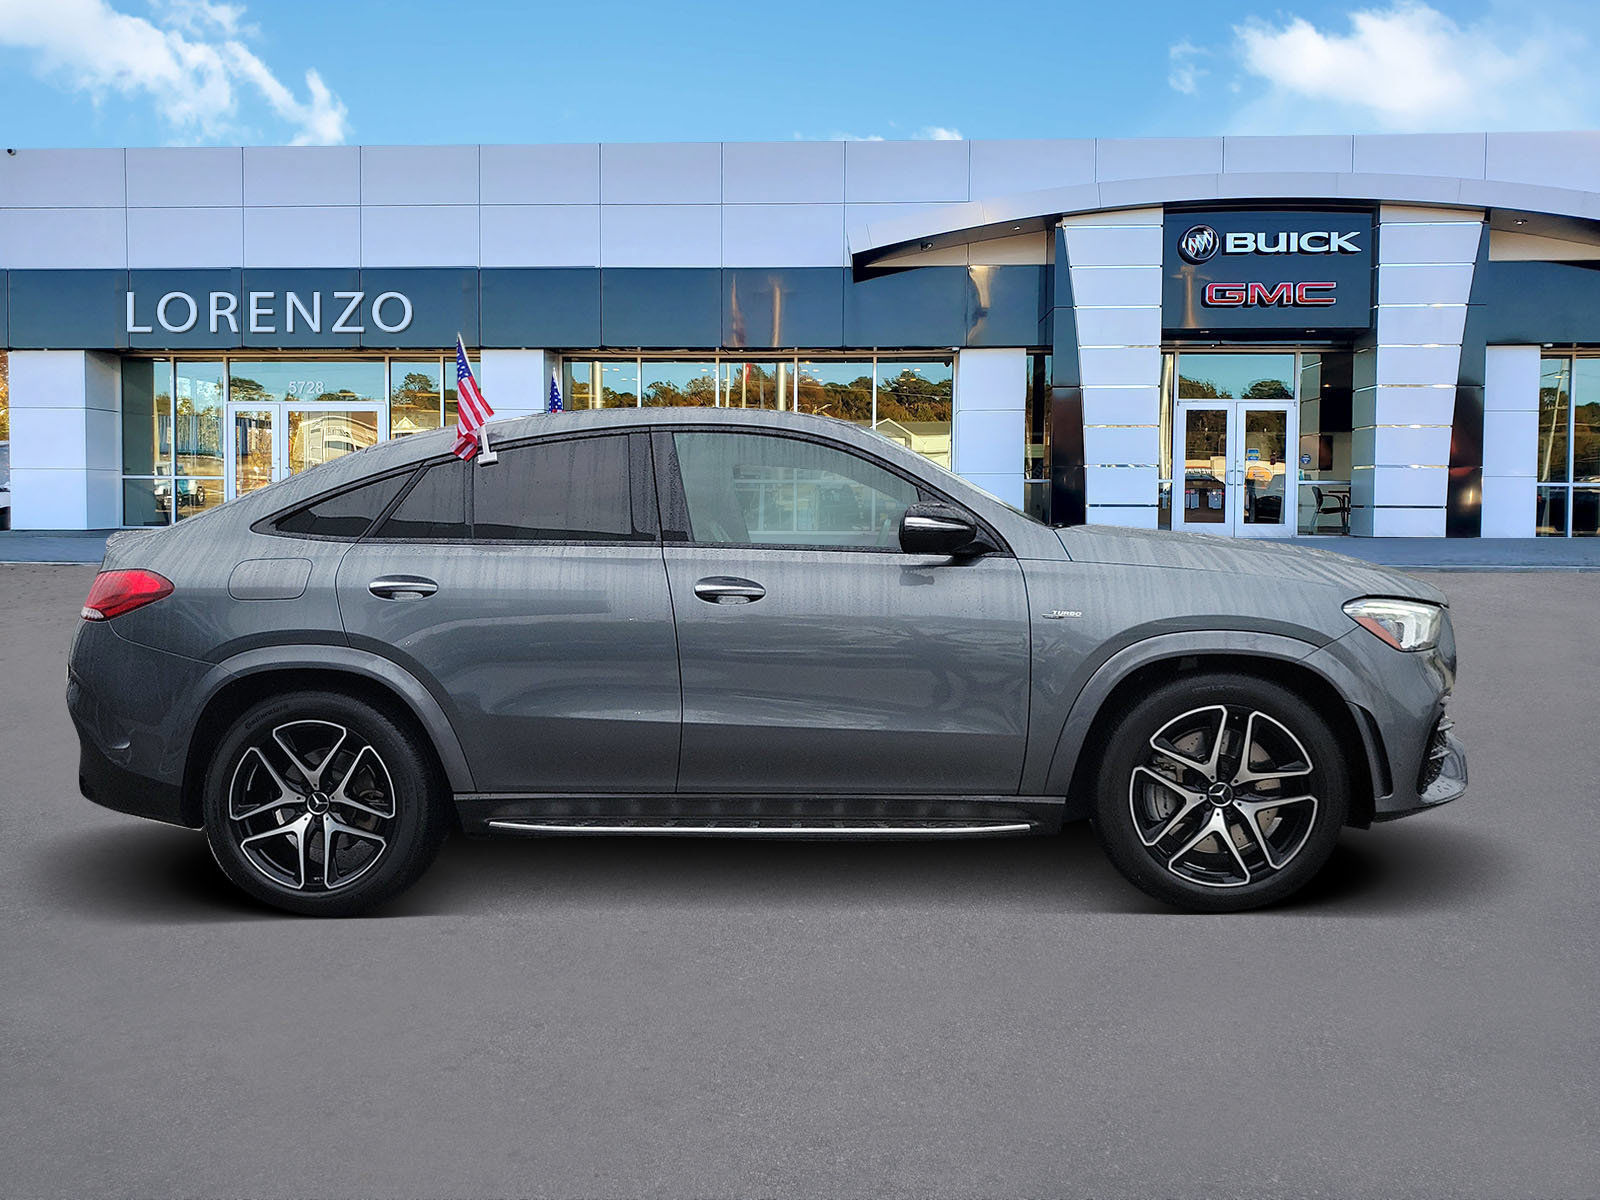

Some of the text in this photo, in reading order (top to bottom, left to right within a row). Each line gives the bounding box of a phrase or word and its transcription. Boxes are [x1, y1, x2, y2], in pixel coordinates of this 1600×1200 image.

[1225, 231, 1362, 253] BUICK
[1204, 282, 1337, 305] GMC
[126, 291, 413, 333] LORENZO
[288, 380, 325, 394] 5728
